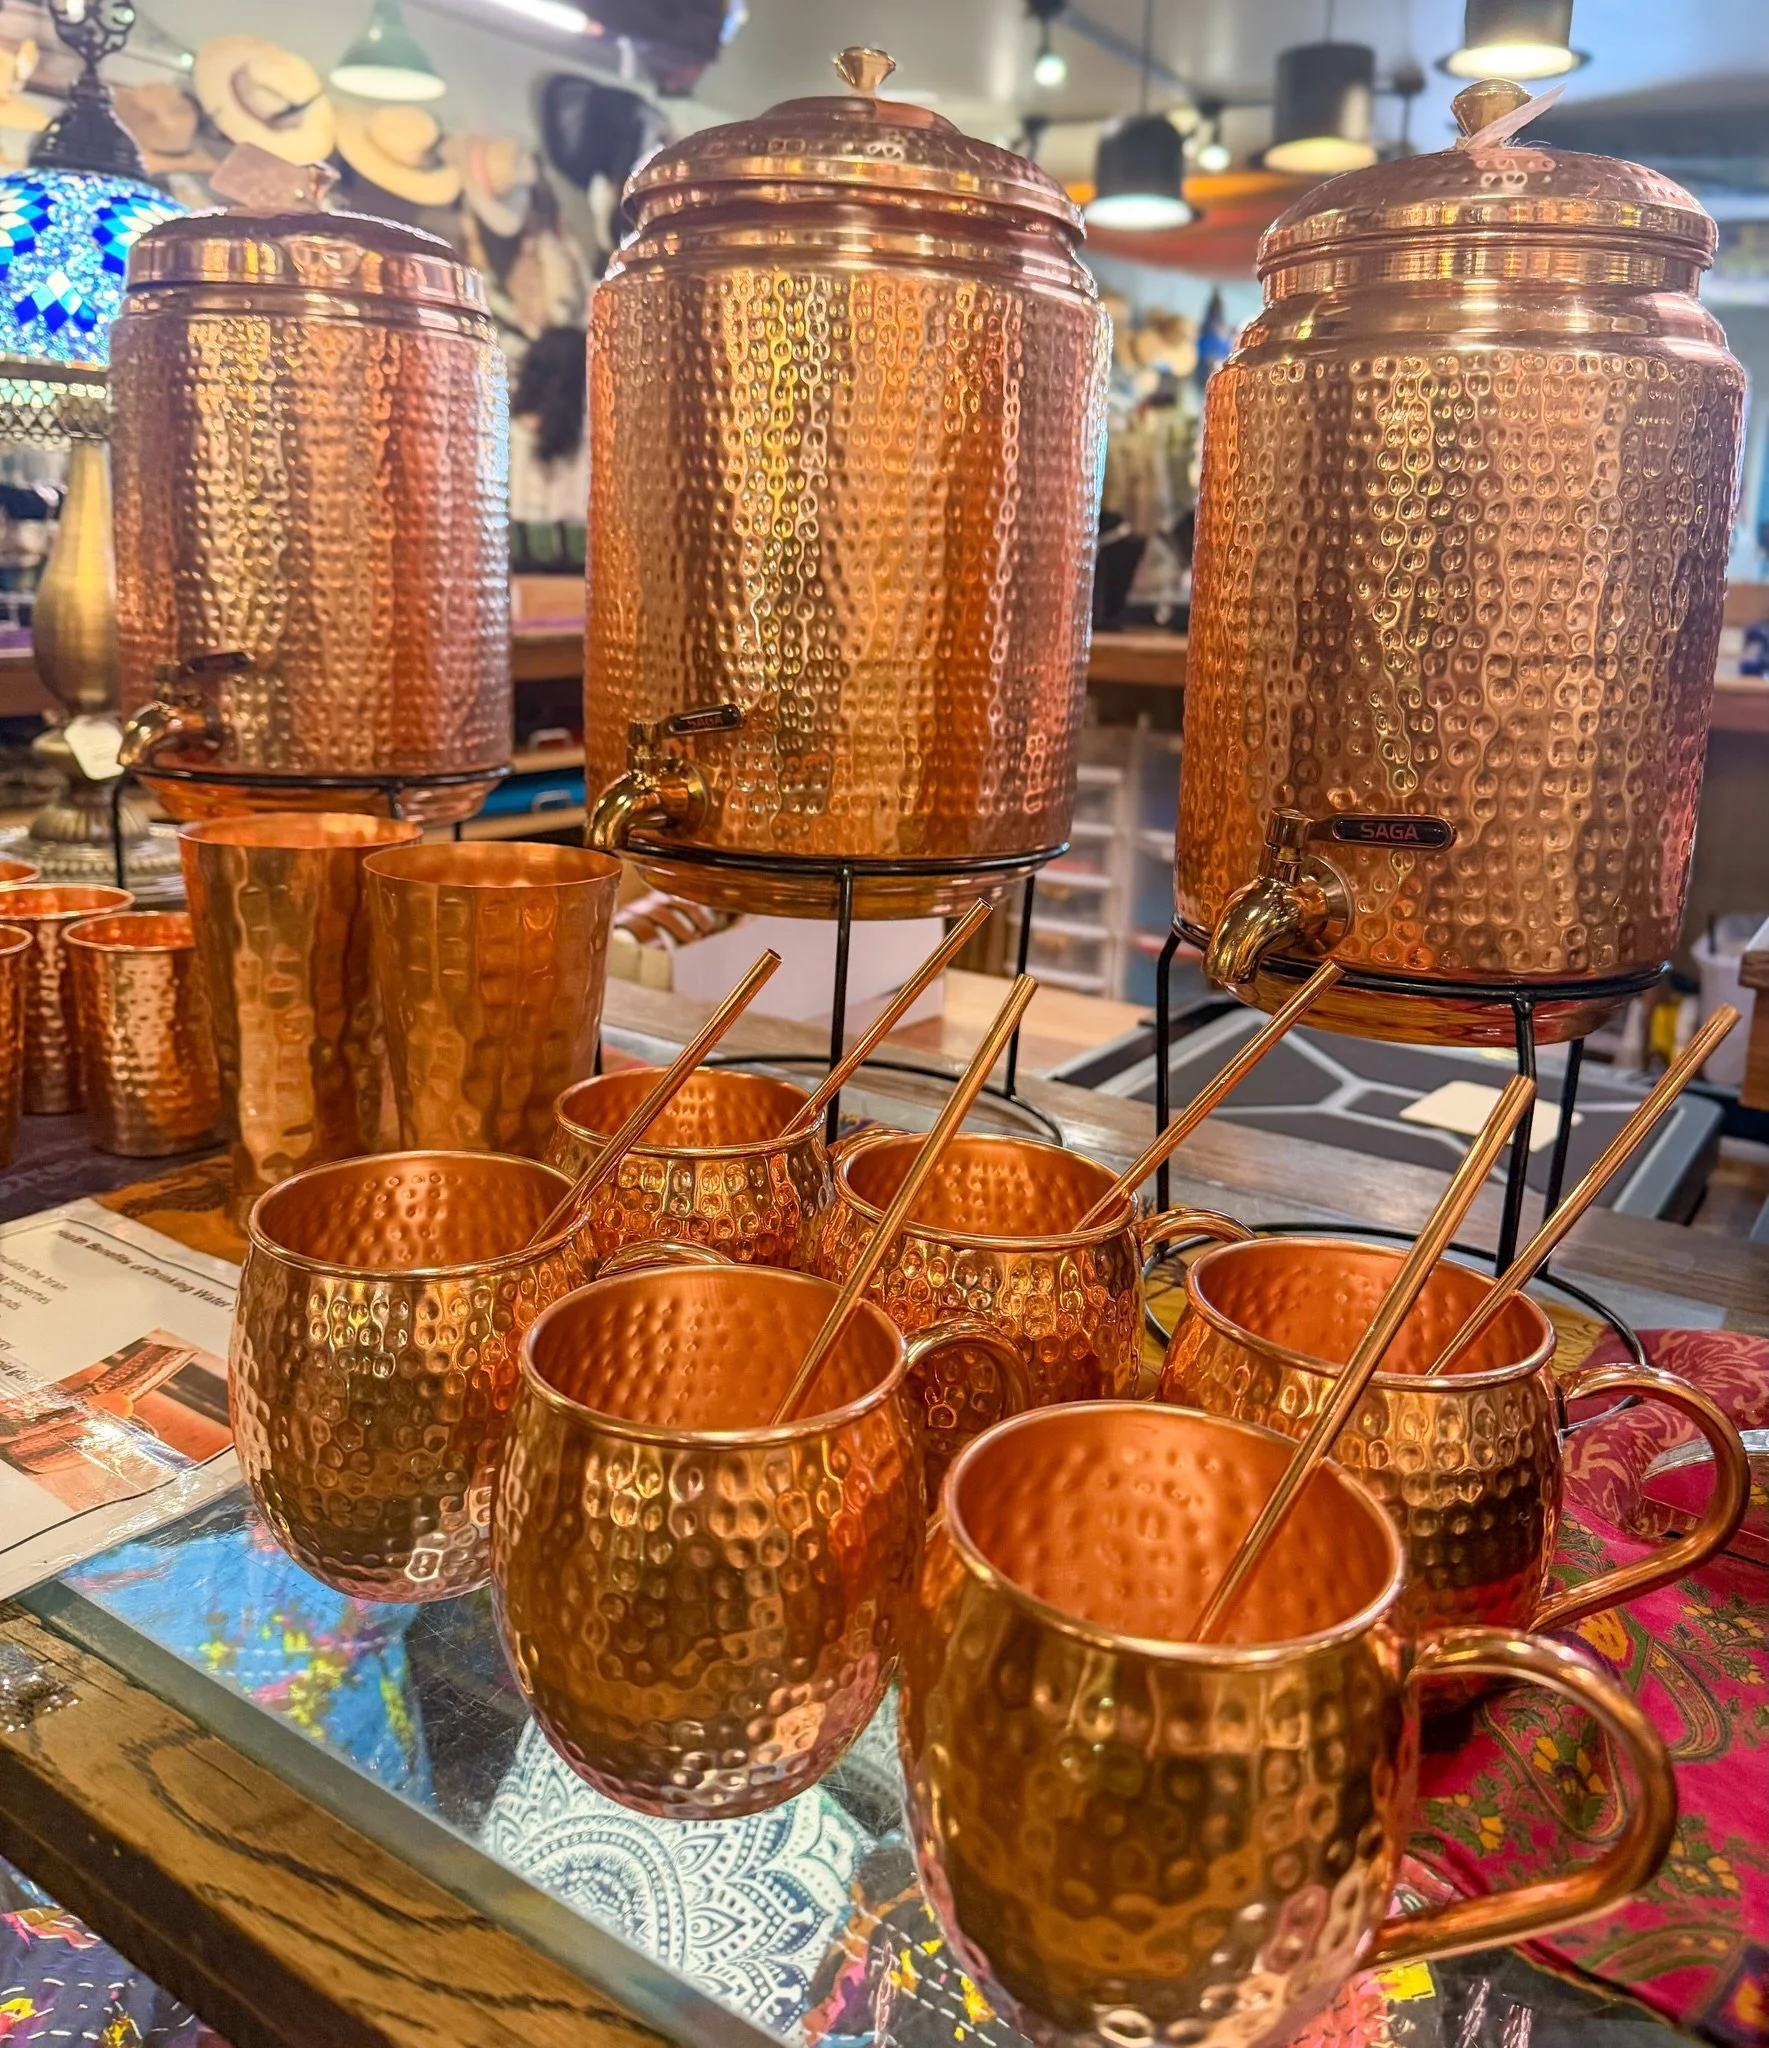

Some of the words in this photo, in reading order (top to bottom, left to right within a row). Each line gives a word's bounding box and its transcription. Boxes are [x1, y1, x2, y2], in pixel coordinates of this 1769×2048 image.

[1360, 822, 1420, 841] SAGA
[142, 1268, 195, 1293] Drinking
[191, 1288, 233, 1308] Water
